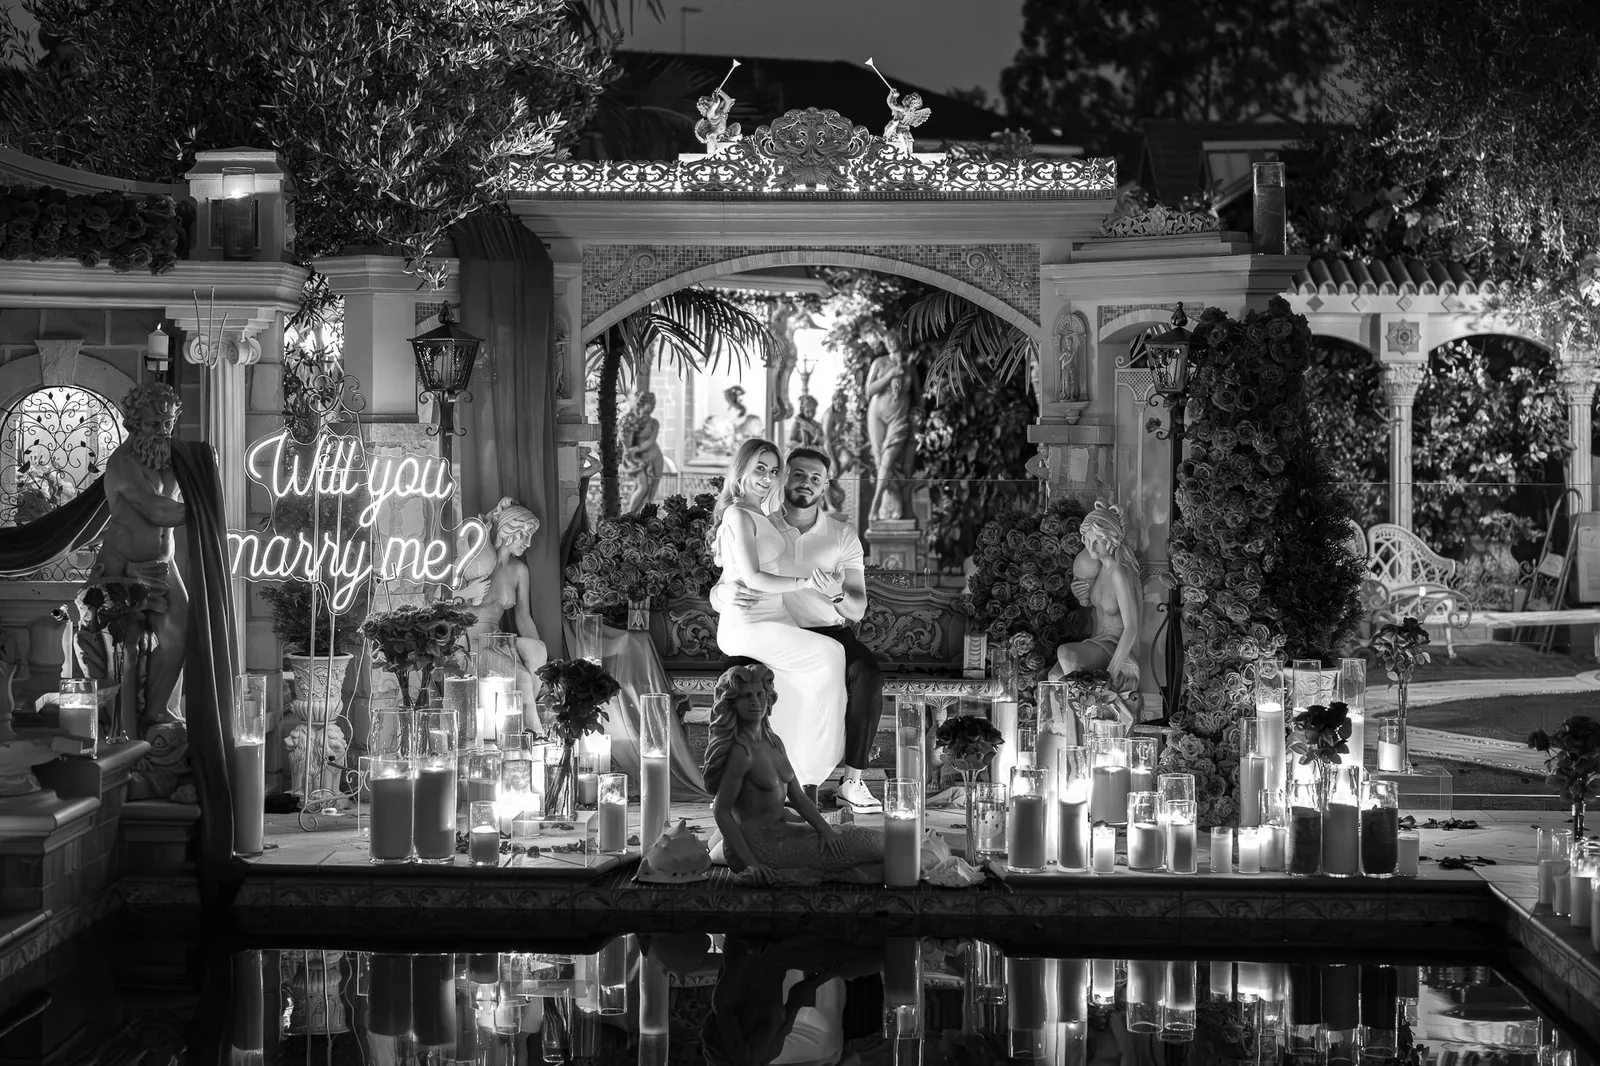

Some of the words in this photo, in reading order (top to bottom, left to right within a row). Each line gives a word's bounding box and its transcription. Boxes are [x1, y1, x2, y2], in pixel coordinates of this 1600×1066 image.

[249, 430, 359, 497] Will
[359, 457, 452, 528] you
[226, 532, 374, 611] marry
[380, 521, 485, 590] me?
